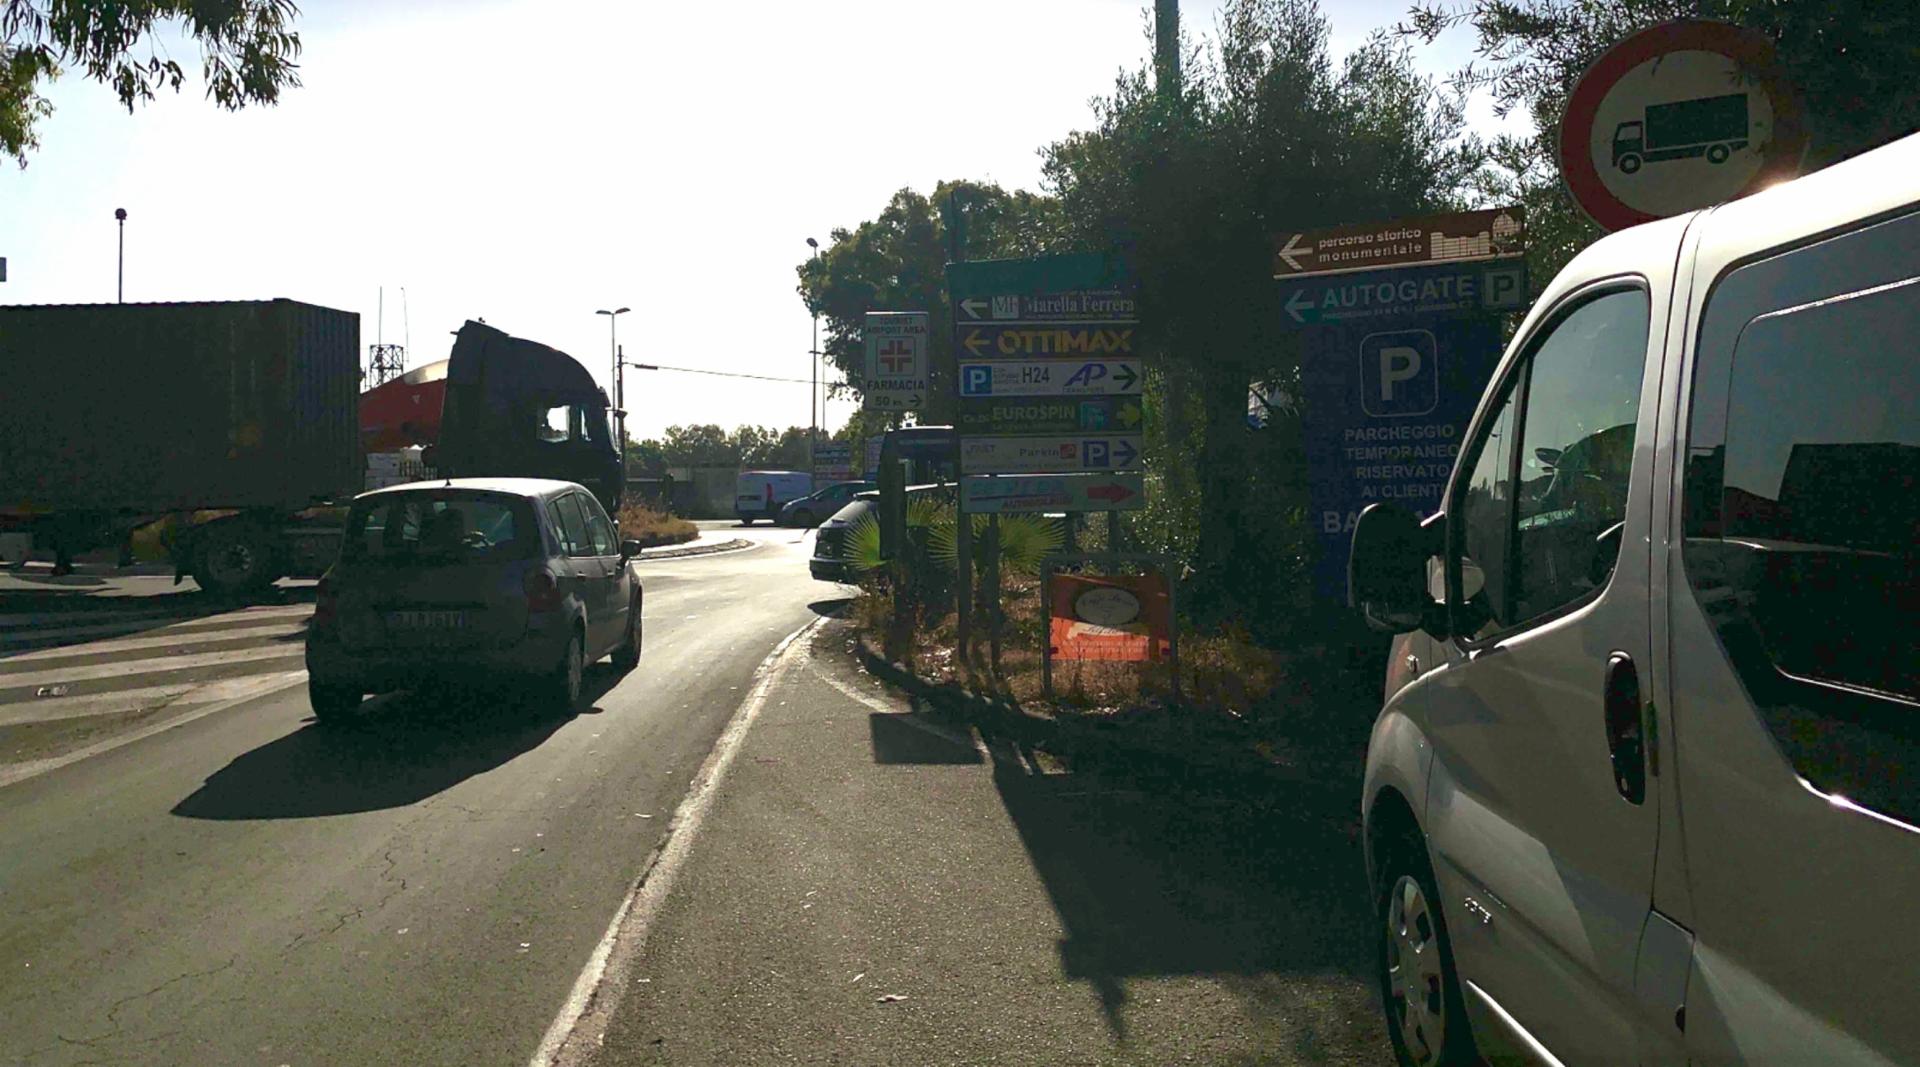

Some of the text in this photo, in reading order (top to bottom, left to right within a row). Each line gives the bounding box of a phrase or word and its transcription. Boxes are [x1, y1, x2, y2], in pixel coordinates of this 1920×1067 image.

[1318, 227, 1422, 250] percorso storico
[1318, 243, 1423, 263] monumentale
[1322, 273, 1475, 309] AUTOGATE
[1499, 274, 1515, 299] P
[1081, 295, 1135, 312] Ferrera
[997, 329, 1136, 354] OTTIMAX
[969, 369, 986, 391] P
[1022, 367, 1050, 383] H24
[1379, 346, 1422, 400] P
[866, 380, 925, 391] FARMACIA
[874, 396, 890, 406] 50
[992, 405, 1076, 421] EUROSPIN
[1344, 424, 1455, 441] PARCHEGGIO
[1089, 444, 1106, 465] P
[1344, 443, 1460, 461] TEMPORANEO
[1356, 464, 1449, 479] RISERVATO
[1361, 486, 1377, 498] AI
